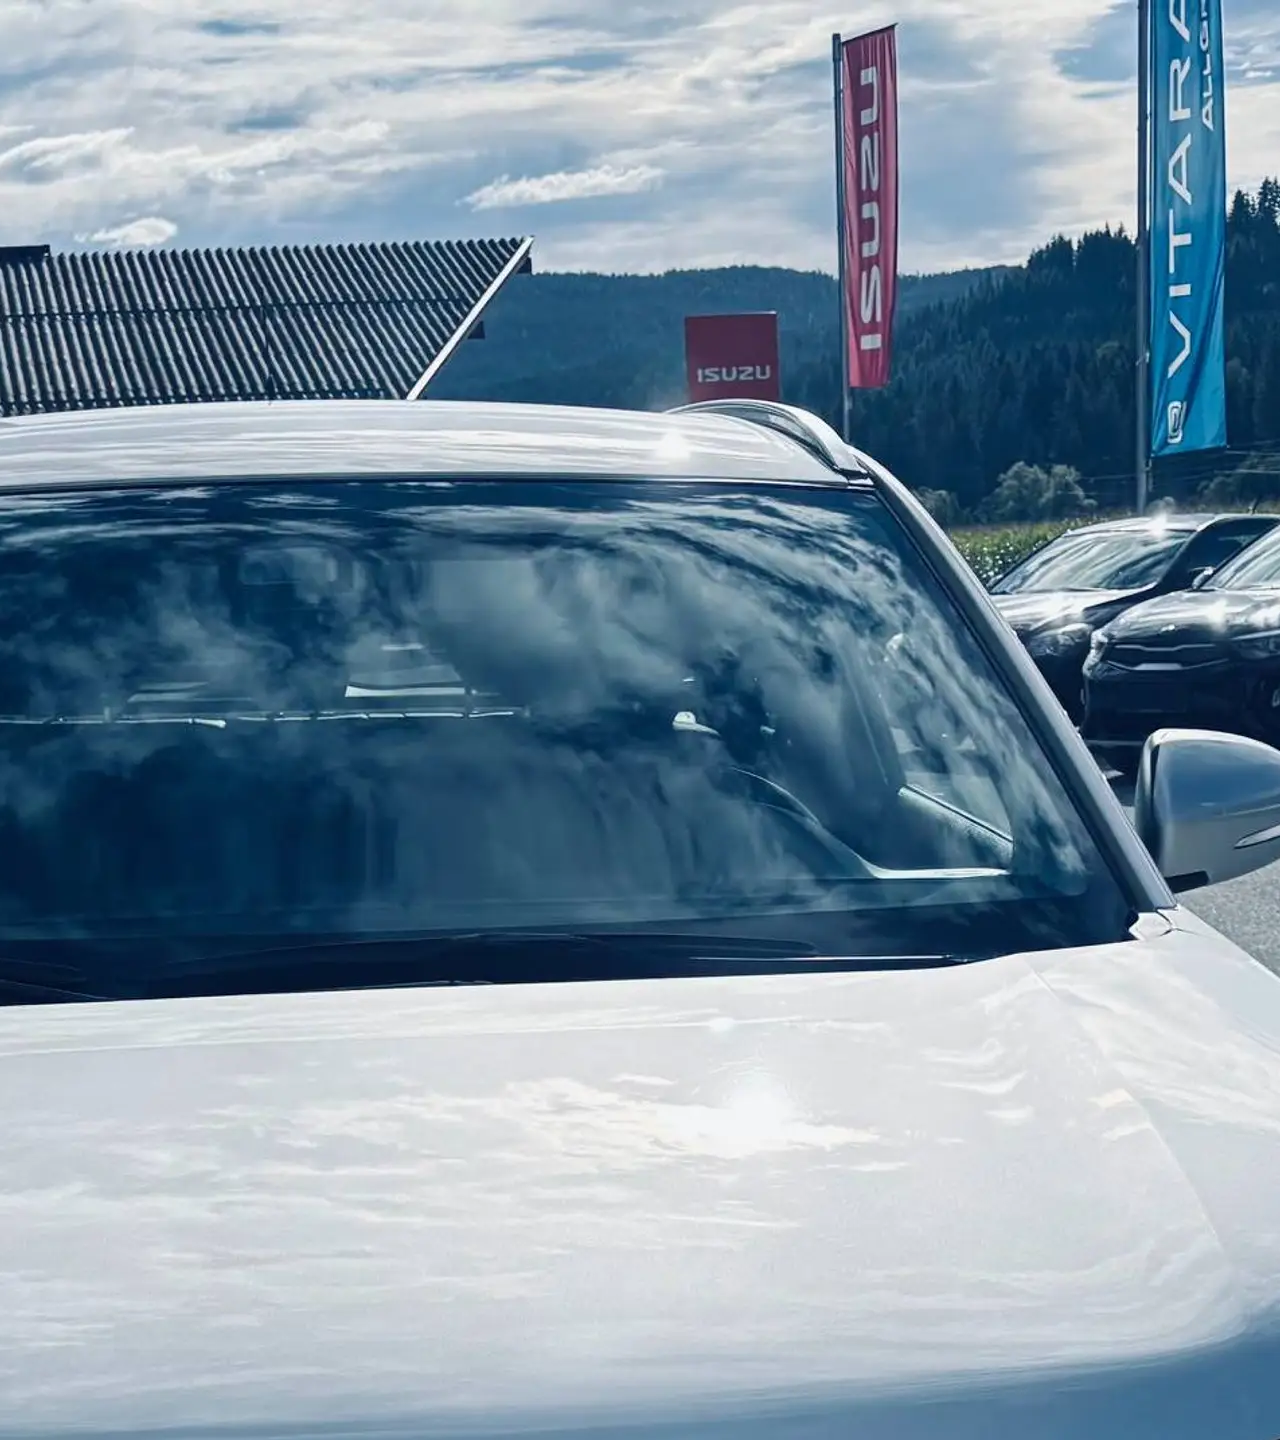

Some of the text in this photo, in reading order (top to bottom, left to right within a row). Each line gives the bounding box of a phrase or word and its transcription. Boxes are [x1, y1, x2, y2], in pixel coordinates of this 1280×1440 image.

[860, 66, 882, 351] ISUZU
[1167, 0, 1193, 379] VITARA
[697, 364, 771, 383] ISUZU
